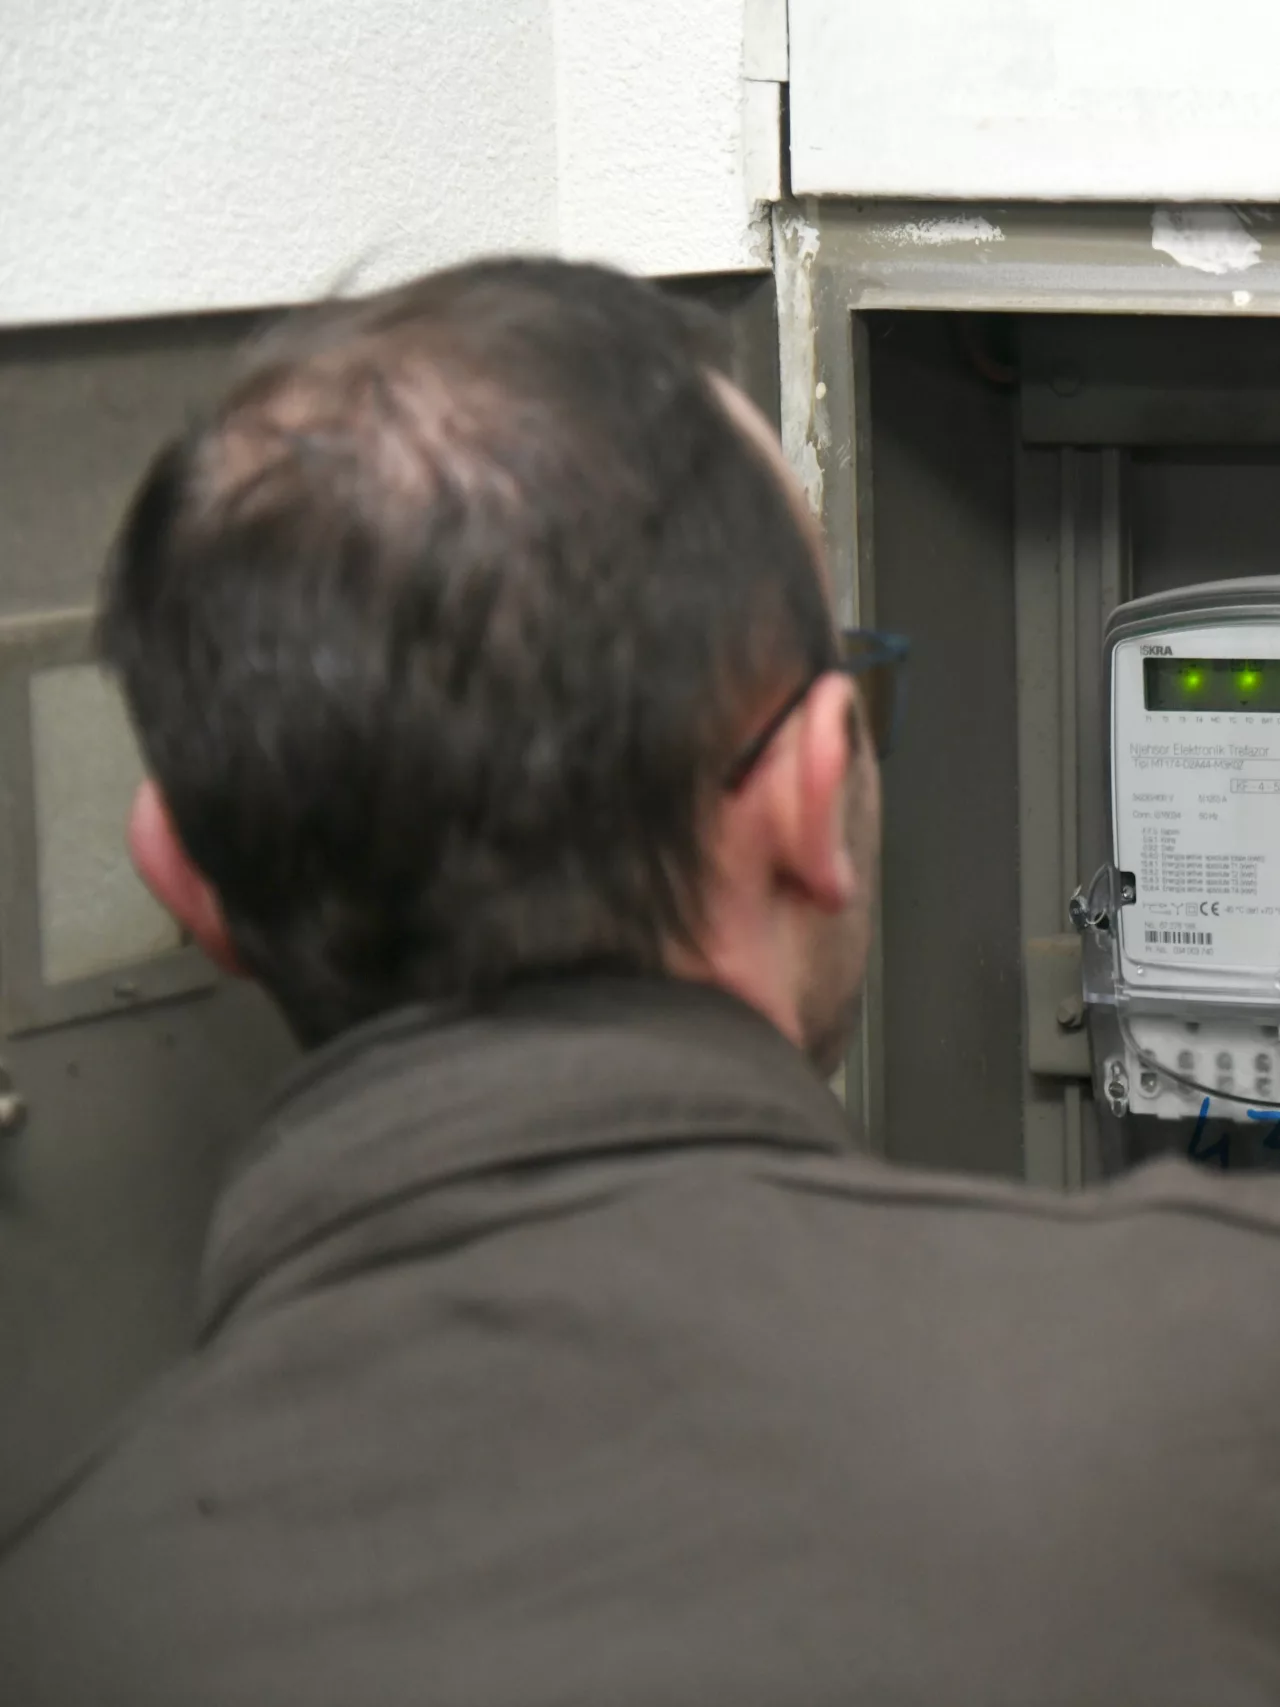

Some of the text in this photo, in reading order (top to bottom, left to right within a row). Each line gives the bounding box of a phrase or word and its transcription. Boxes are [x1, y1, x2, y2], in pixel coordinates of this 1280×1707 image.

[1140, 645, 1173, 656] ISKRA
[1173, 744, 1225, 757] Elektronik
[1200, 901, 1220, 917] CE
